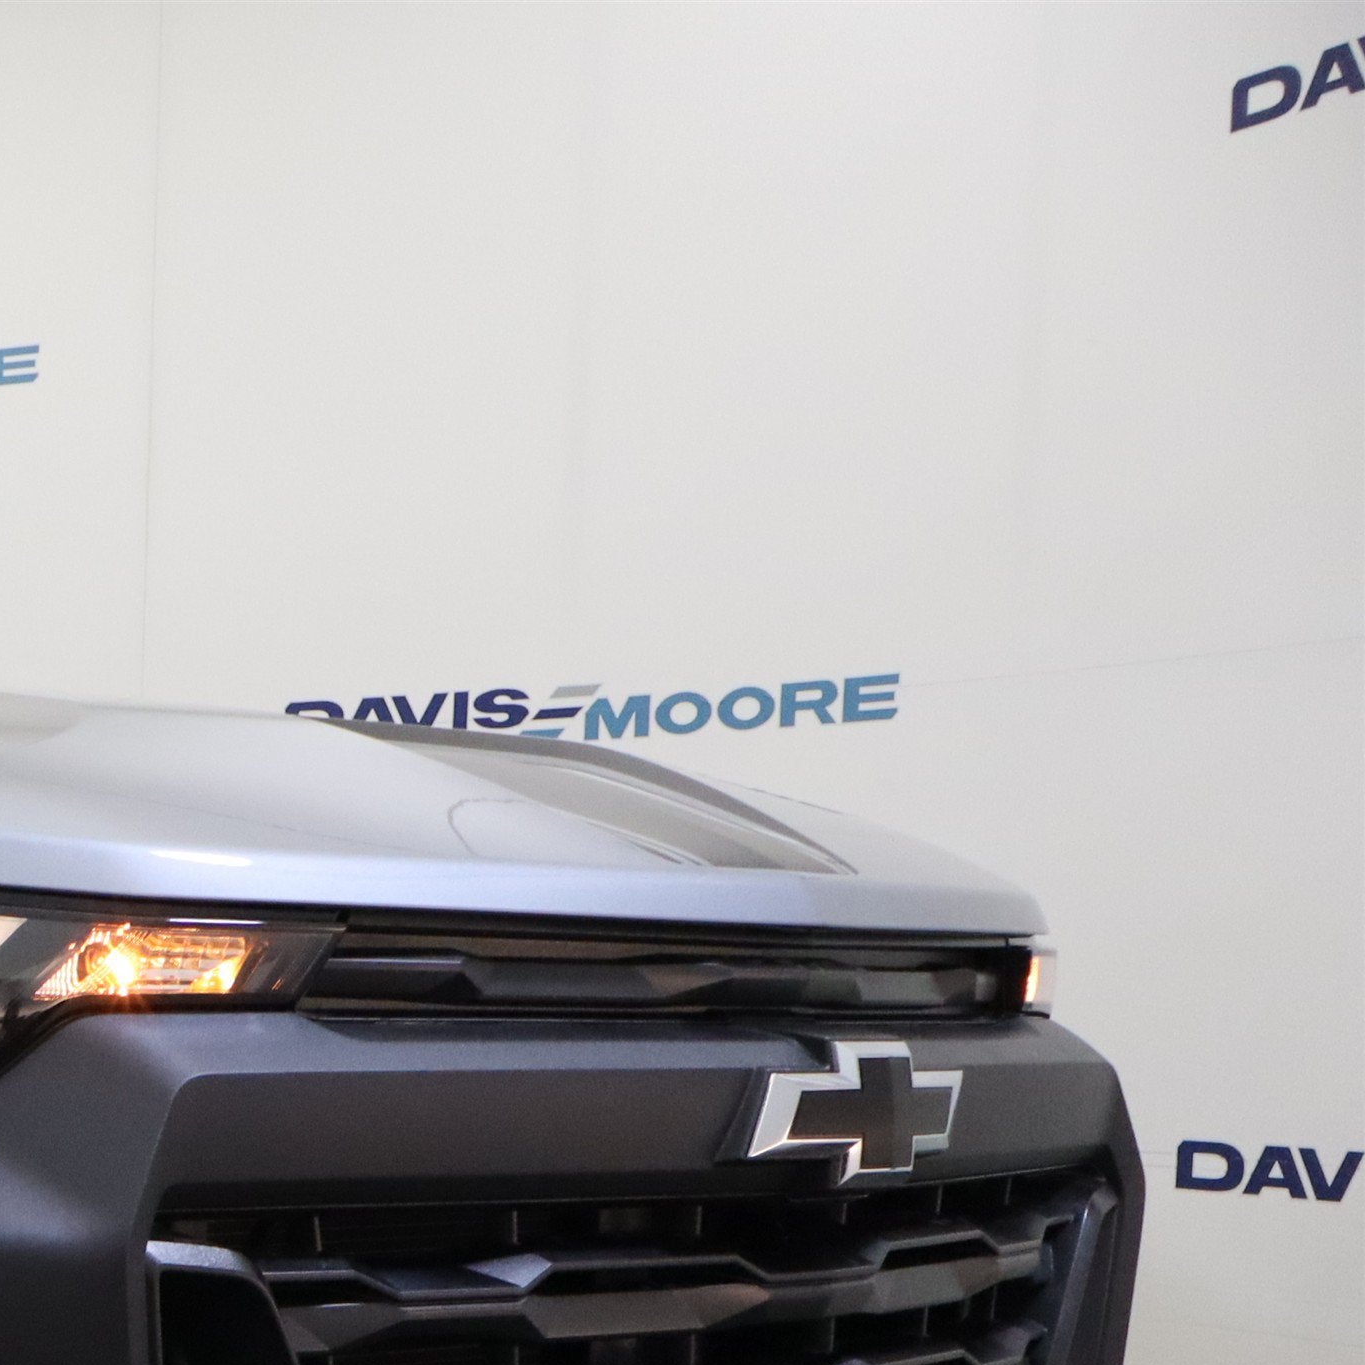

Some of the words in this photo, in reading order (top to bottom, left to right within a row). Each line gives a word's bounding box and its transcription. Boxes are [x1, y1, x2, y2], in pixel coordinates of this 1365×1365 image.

[1230, 35, 1365, 133] DA
[583, 672, 901, 742] MOORE
[1174, 1139, 1365, 1203] DAV
